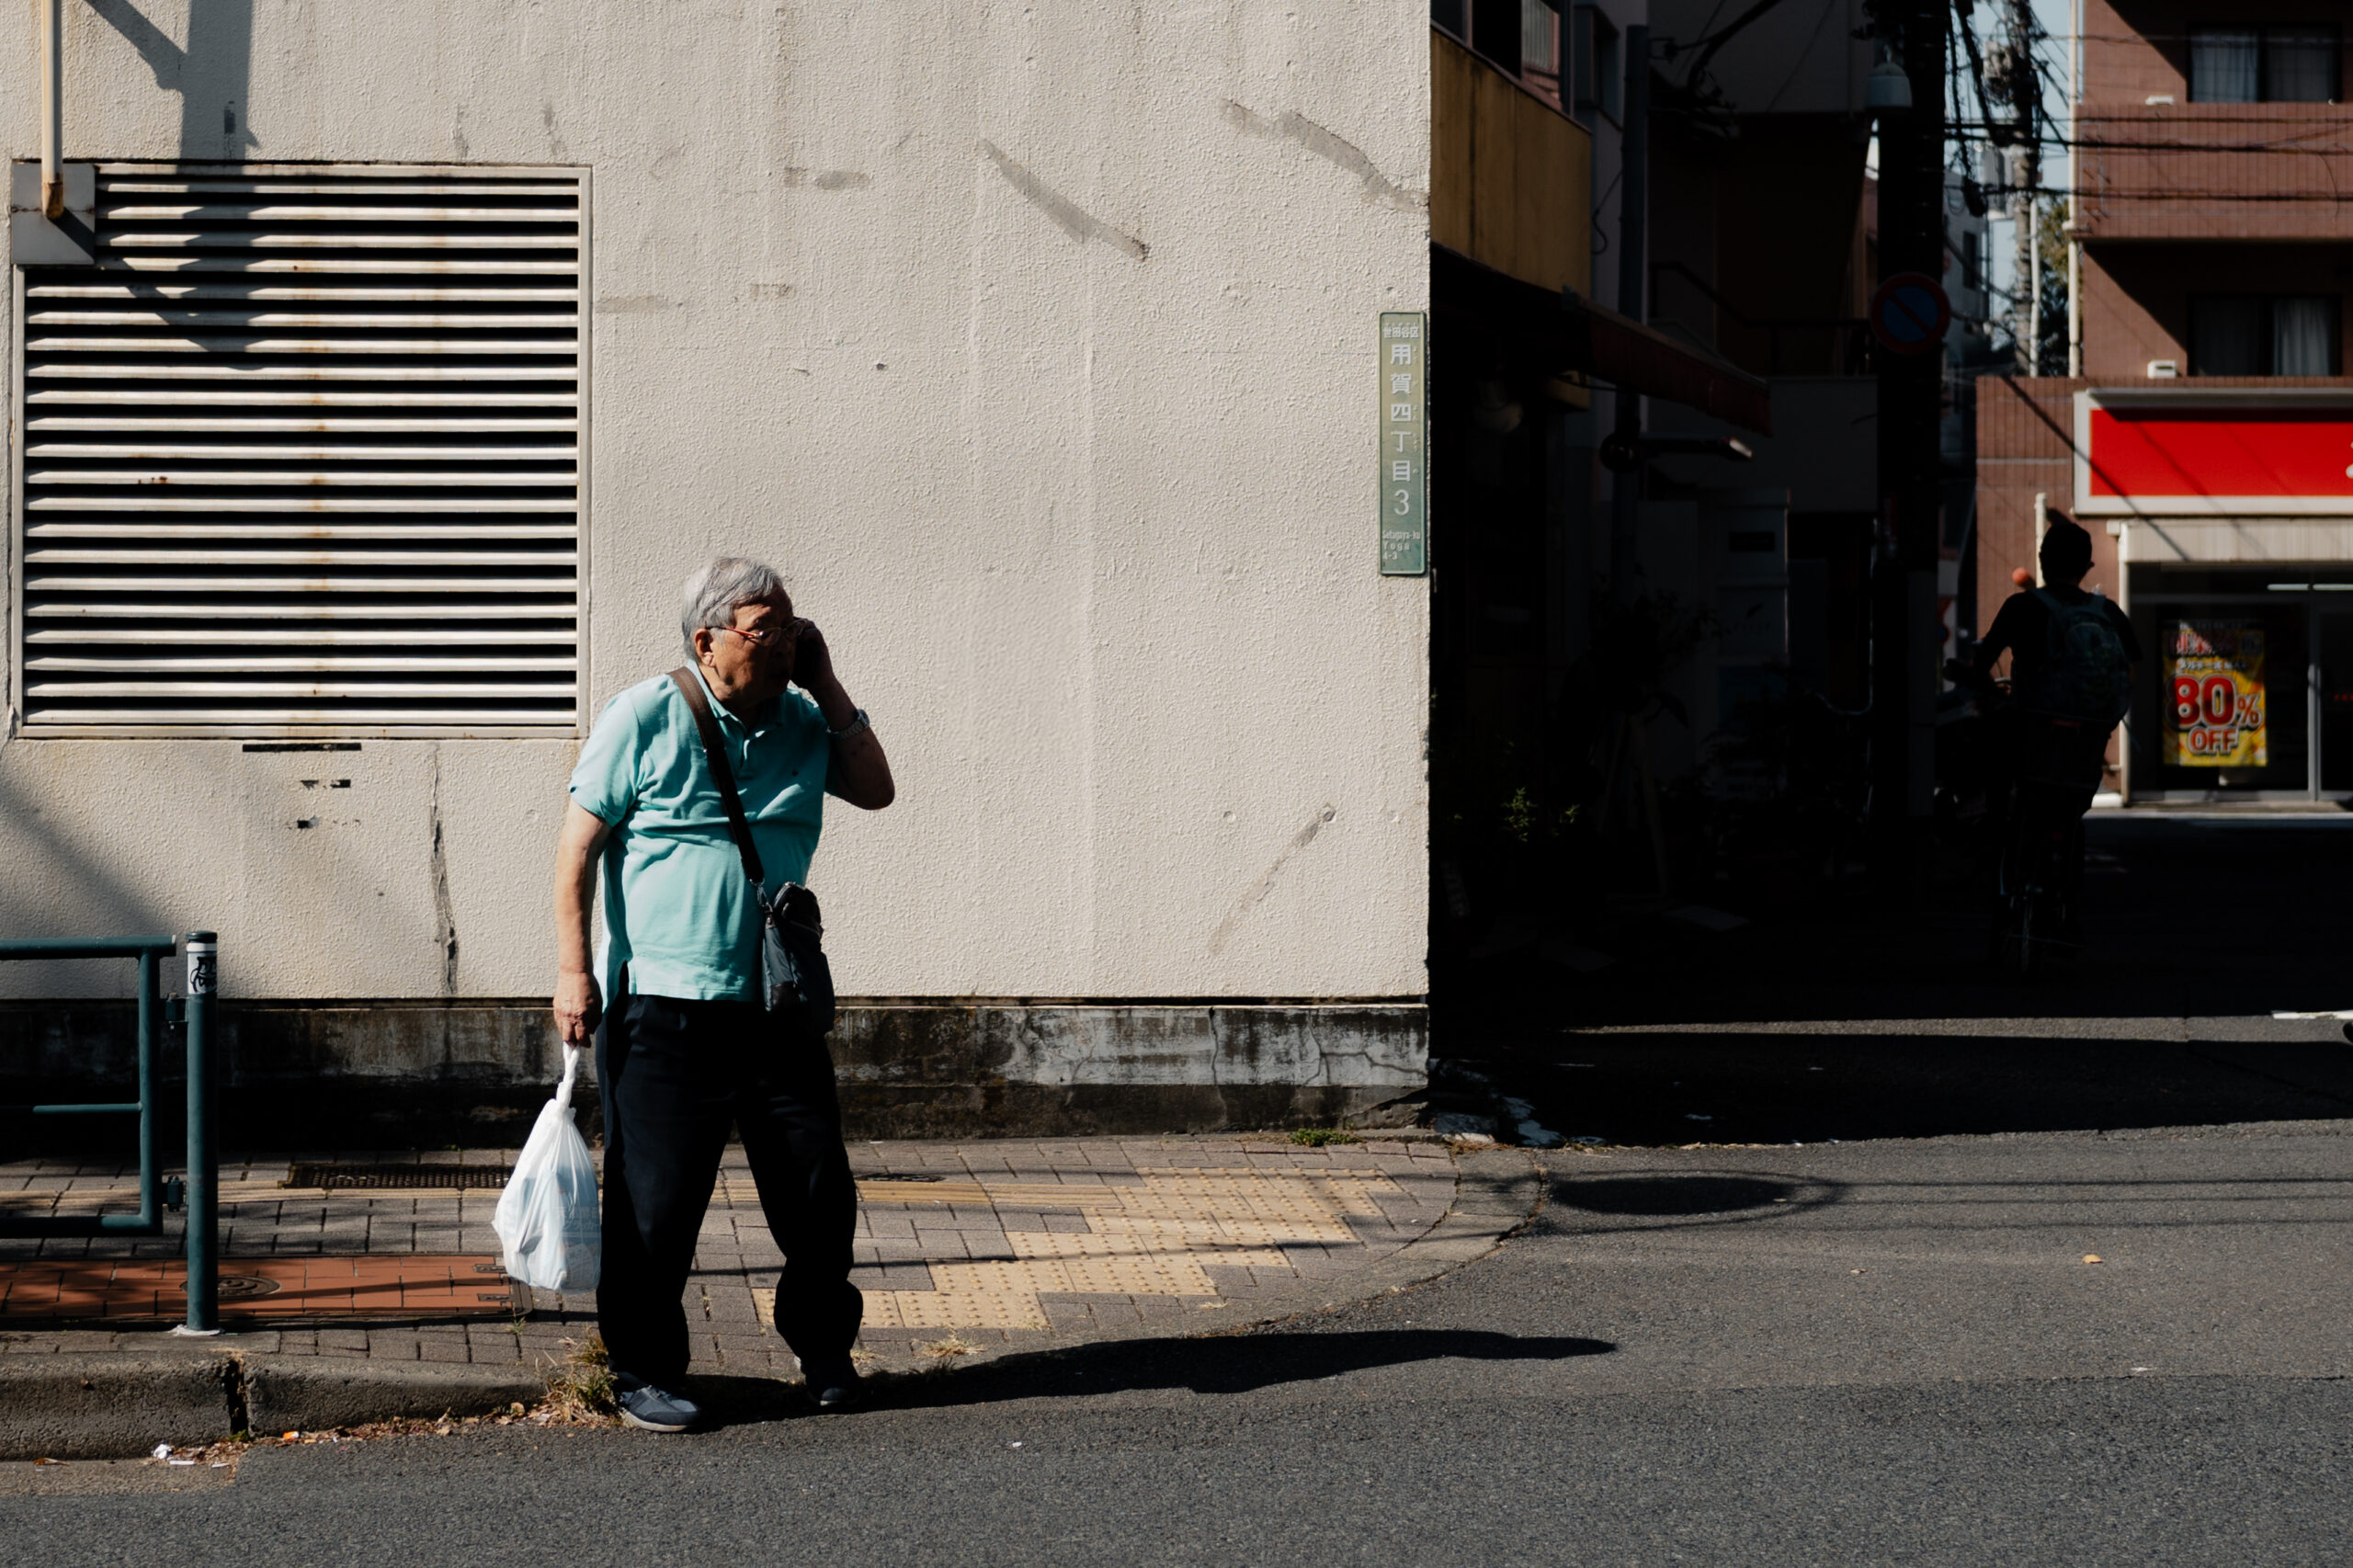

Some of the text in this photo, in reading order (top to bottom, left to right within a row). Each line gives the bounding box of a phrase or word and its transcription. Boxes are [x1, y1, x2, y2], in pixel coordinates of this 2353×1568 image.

[1382, 325, 1419, 337] 世田谷区
[1381, 529, 1421, 540] Setagaya-ku
[1382, 540, 1410, 549] Yoga
[1382, 551, 1398, 561] 4-3
[2166, 675, 2263, 729] 80%
[2188, 726, 2239, 756] OFF
